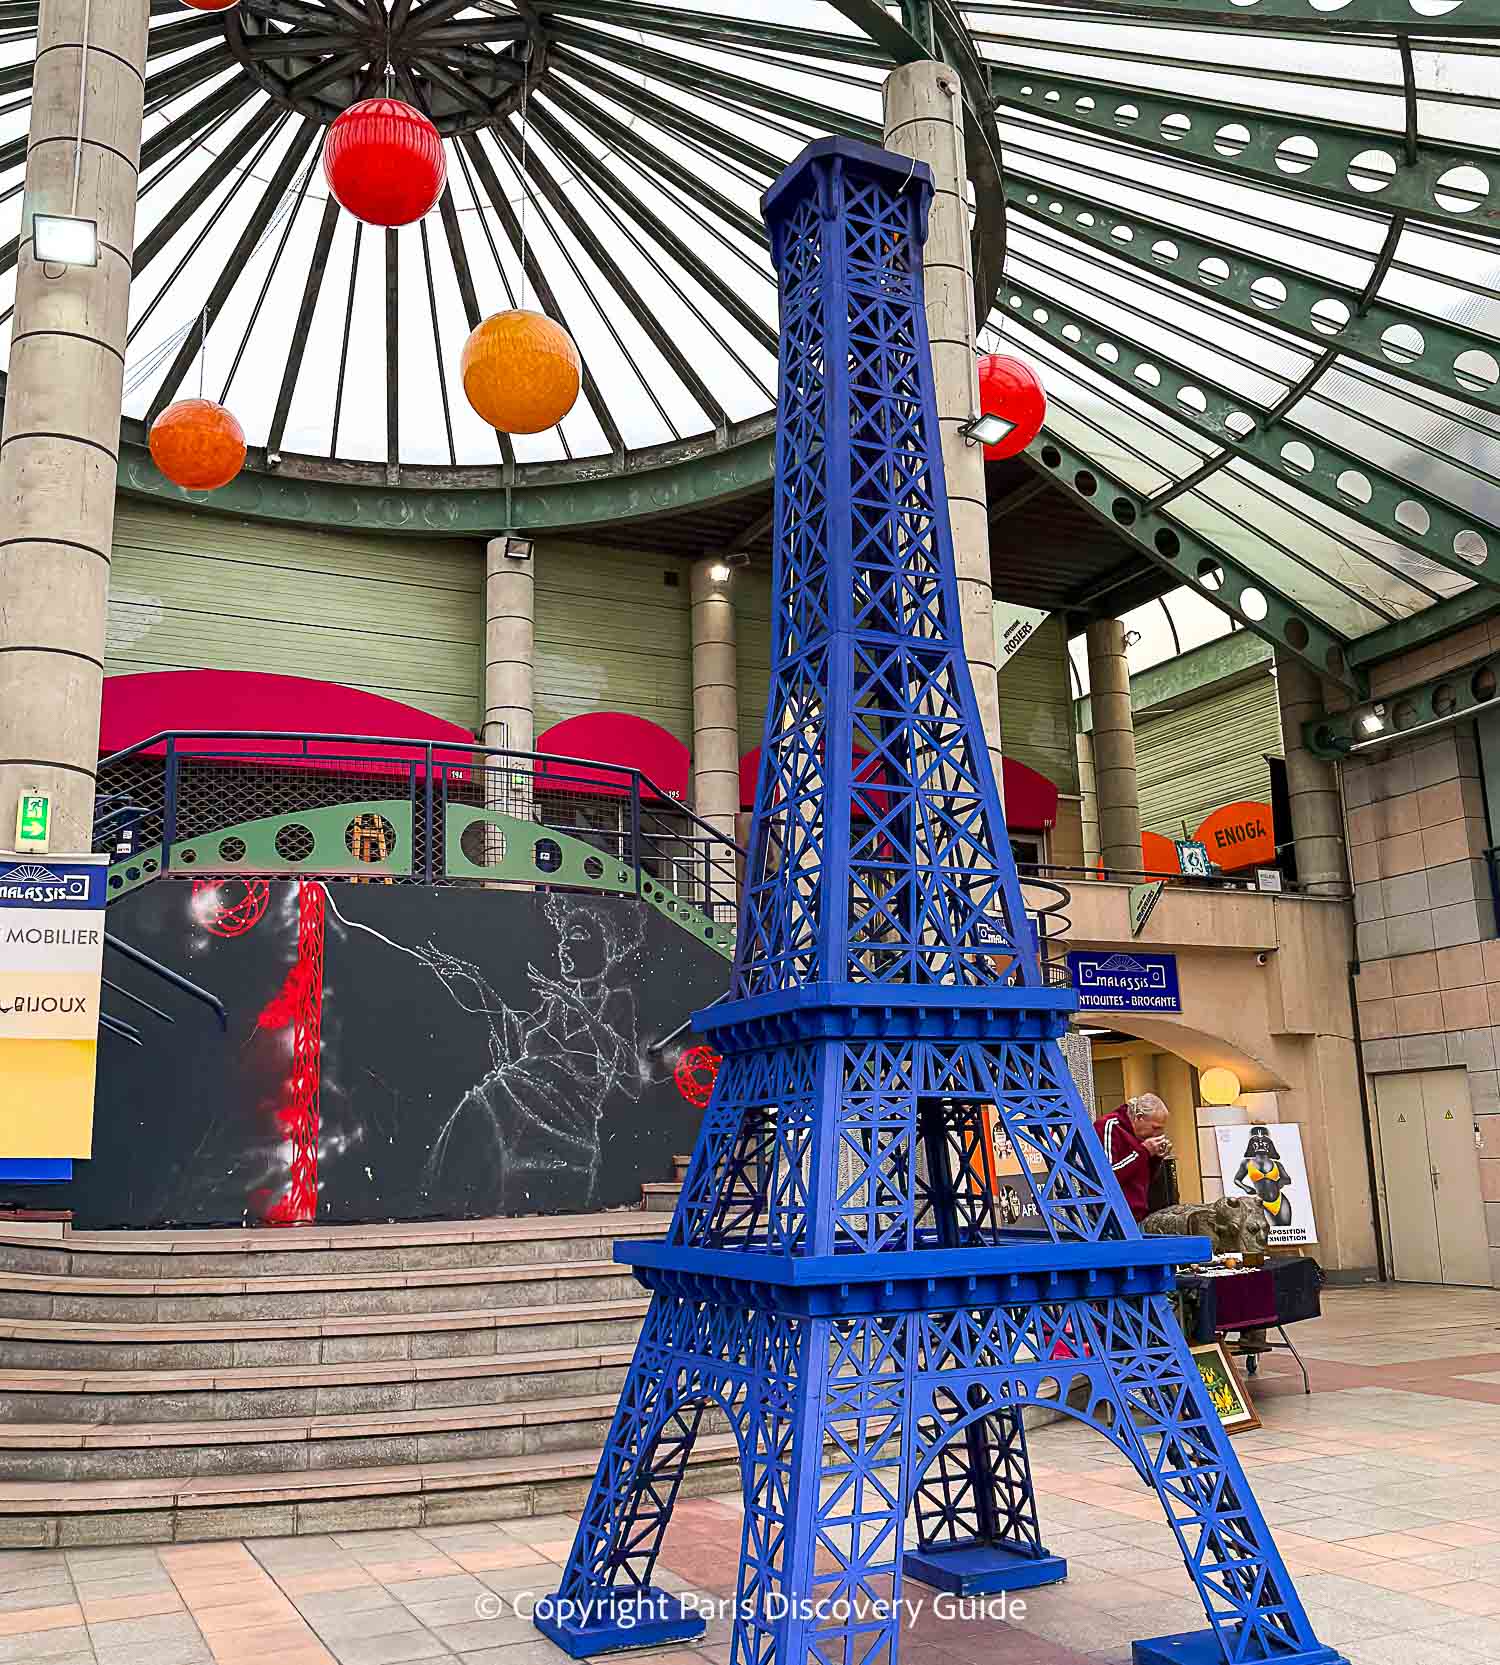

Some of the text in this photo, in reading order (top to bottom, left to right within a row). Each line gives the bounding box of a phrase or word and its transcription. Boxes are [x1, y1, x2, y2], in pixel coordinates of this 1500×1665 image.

[1003, 621, 1032, 654] ROSIERS
[6, 928, 99, 945] MOBILIER
[1079, 995, 1124, 1006] NTIQUITES
[1131, 996, 1177, 1007] BROCANTE
